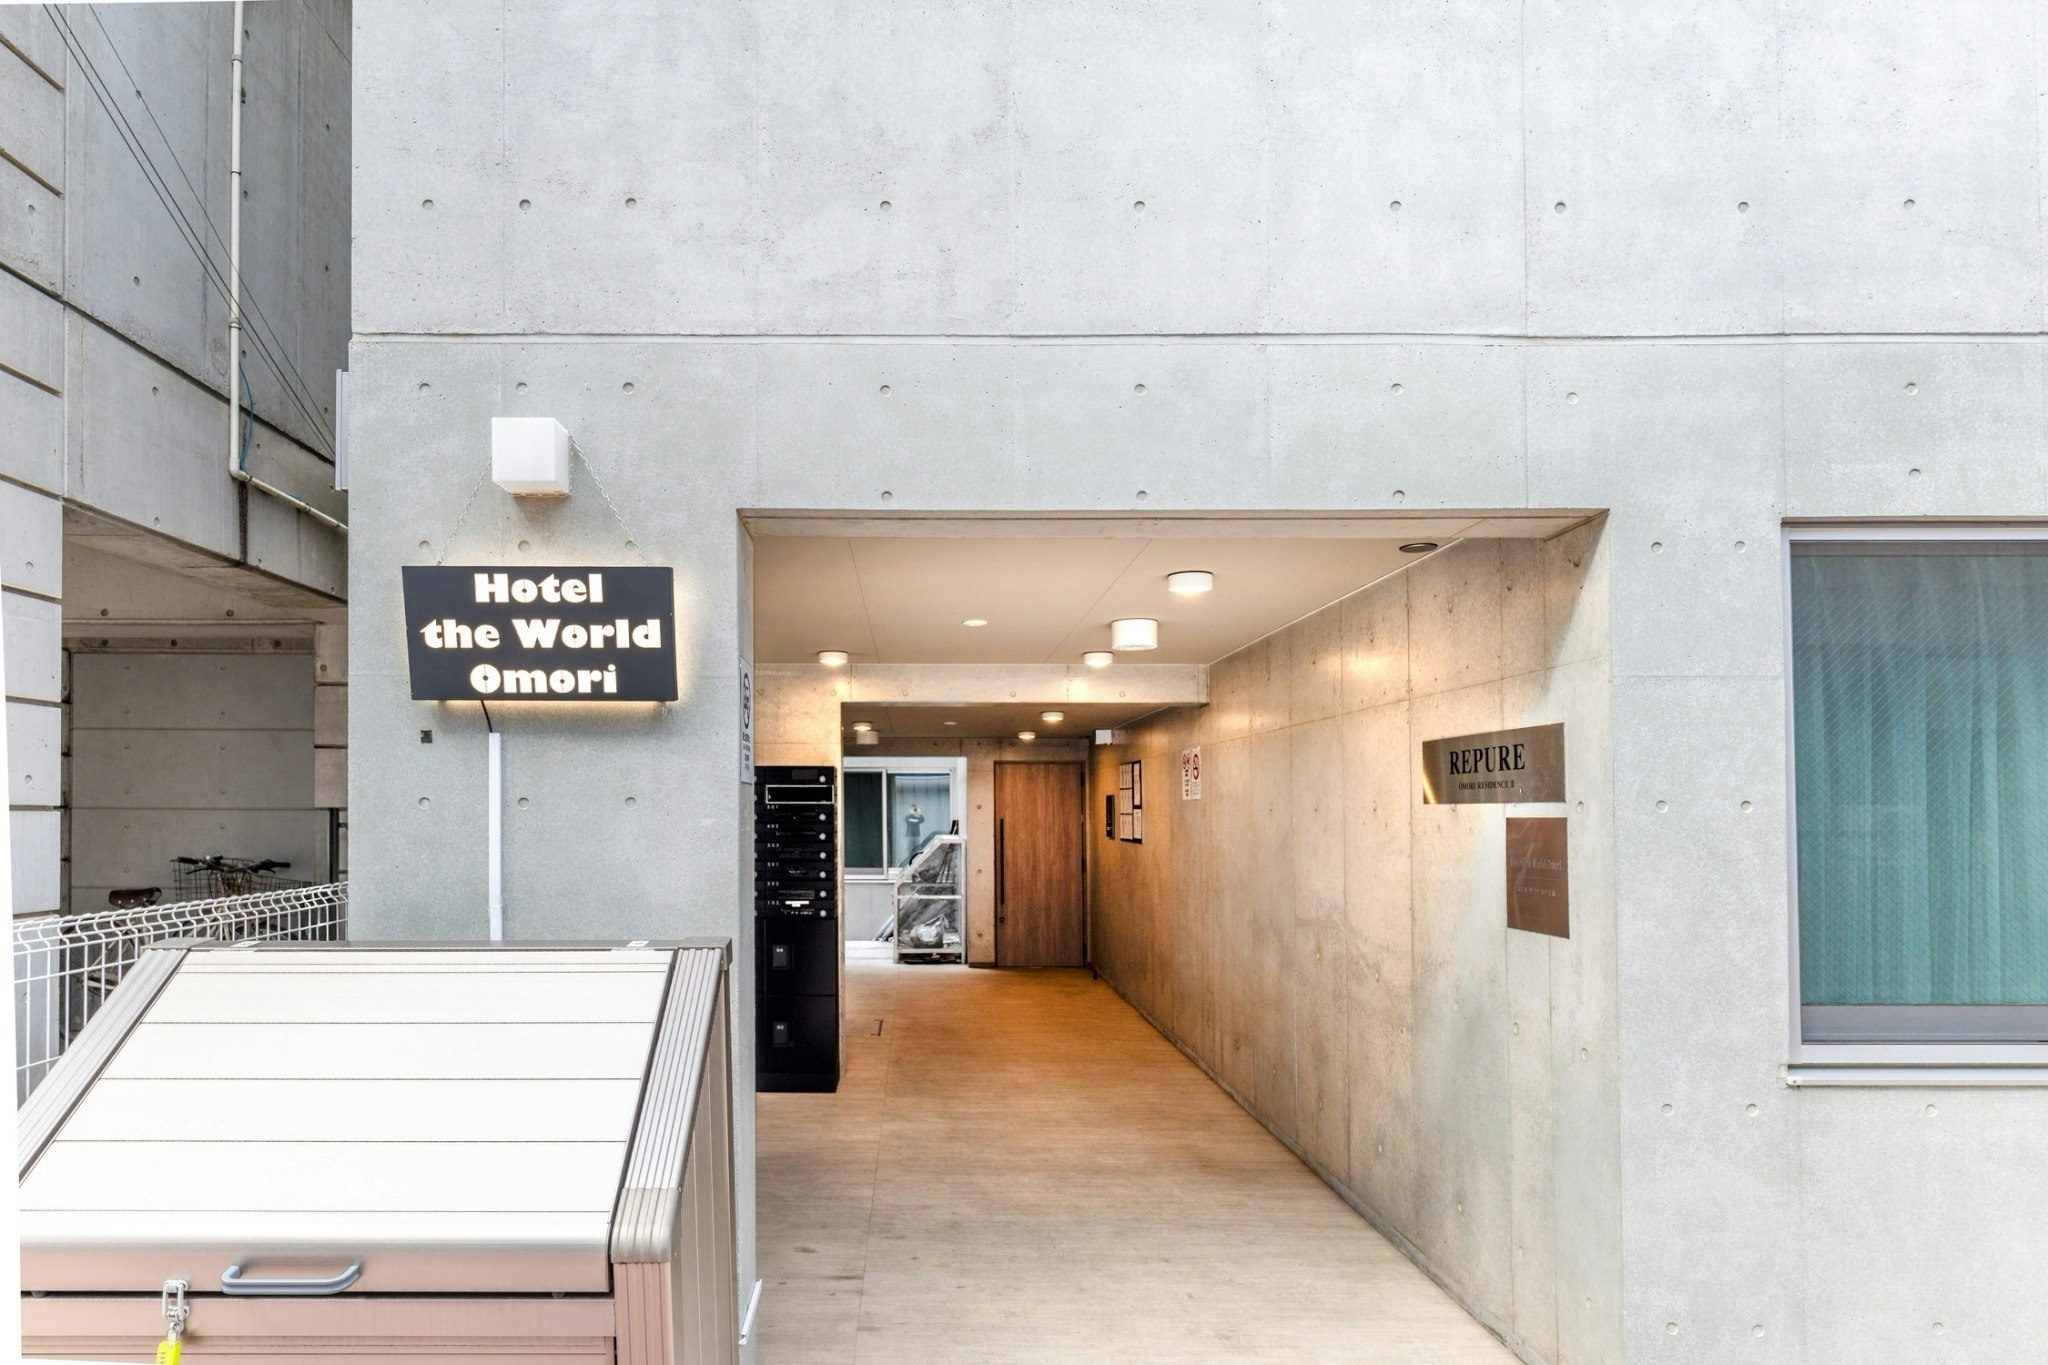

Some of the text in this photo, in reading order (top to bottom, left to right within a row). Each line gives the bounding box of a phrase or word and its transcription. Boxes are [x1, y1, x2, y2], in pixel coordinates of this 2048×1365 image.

[474, 573, 603, 603] Hotel
[419, 618, 662, 649] the World
[470, 663, 618, 694] Omori
[1449, 743, 1525, 775] REPURE
[1477, 780, 1509, 790] RESIDENCE
